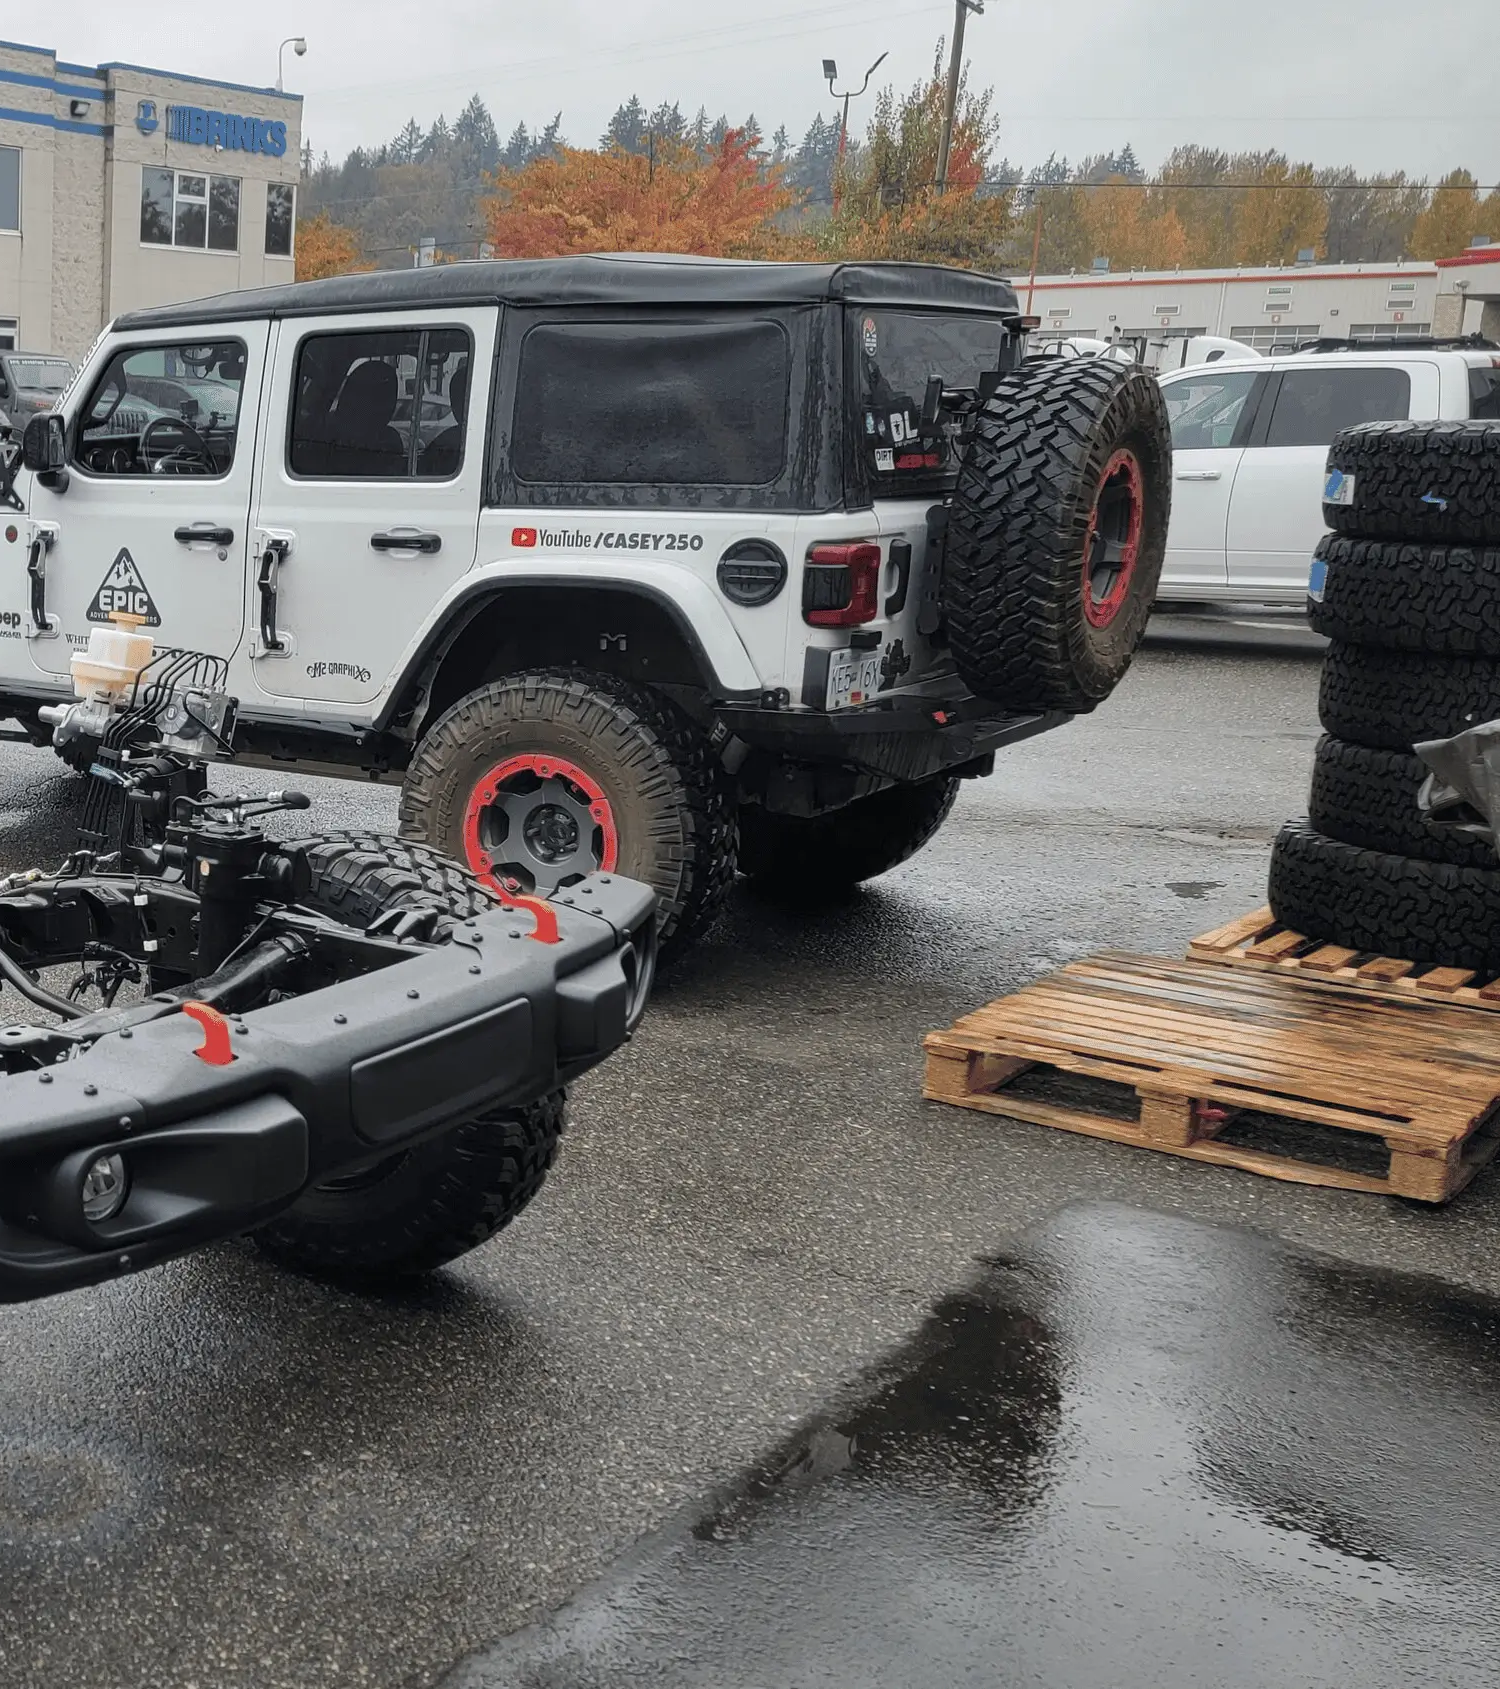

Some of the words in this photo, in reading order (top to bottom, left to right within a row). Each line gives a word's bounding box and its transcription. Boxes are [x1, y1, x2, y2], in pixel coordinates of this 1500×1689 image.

[188, 106, 287, 157] BRINKS
[876, 450, 892, 462] DIRT
[539, 529, 591, 548] YouTube
[593, 532, 704, 551] /CASEY250
[99, 589, 149, 614] EPIC
